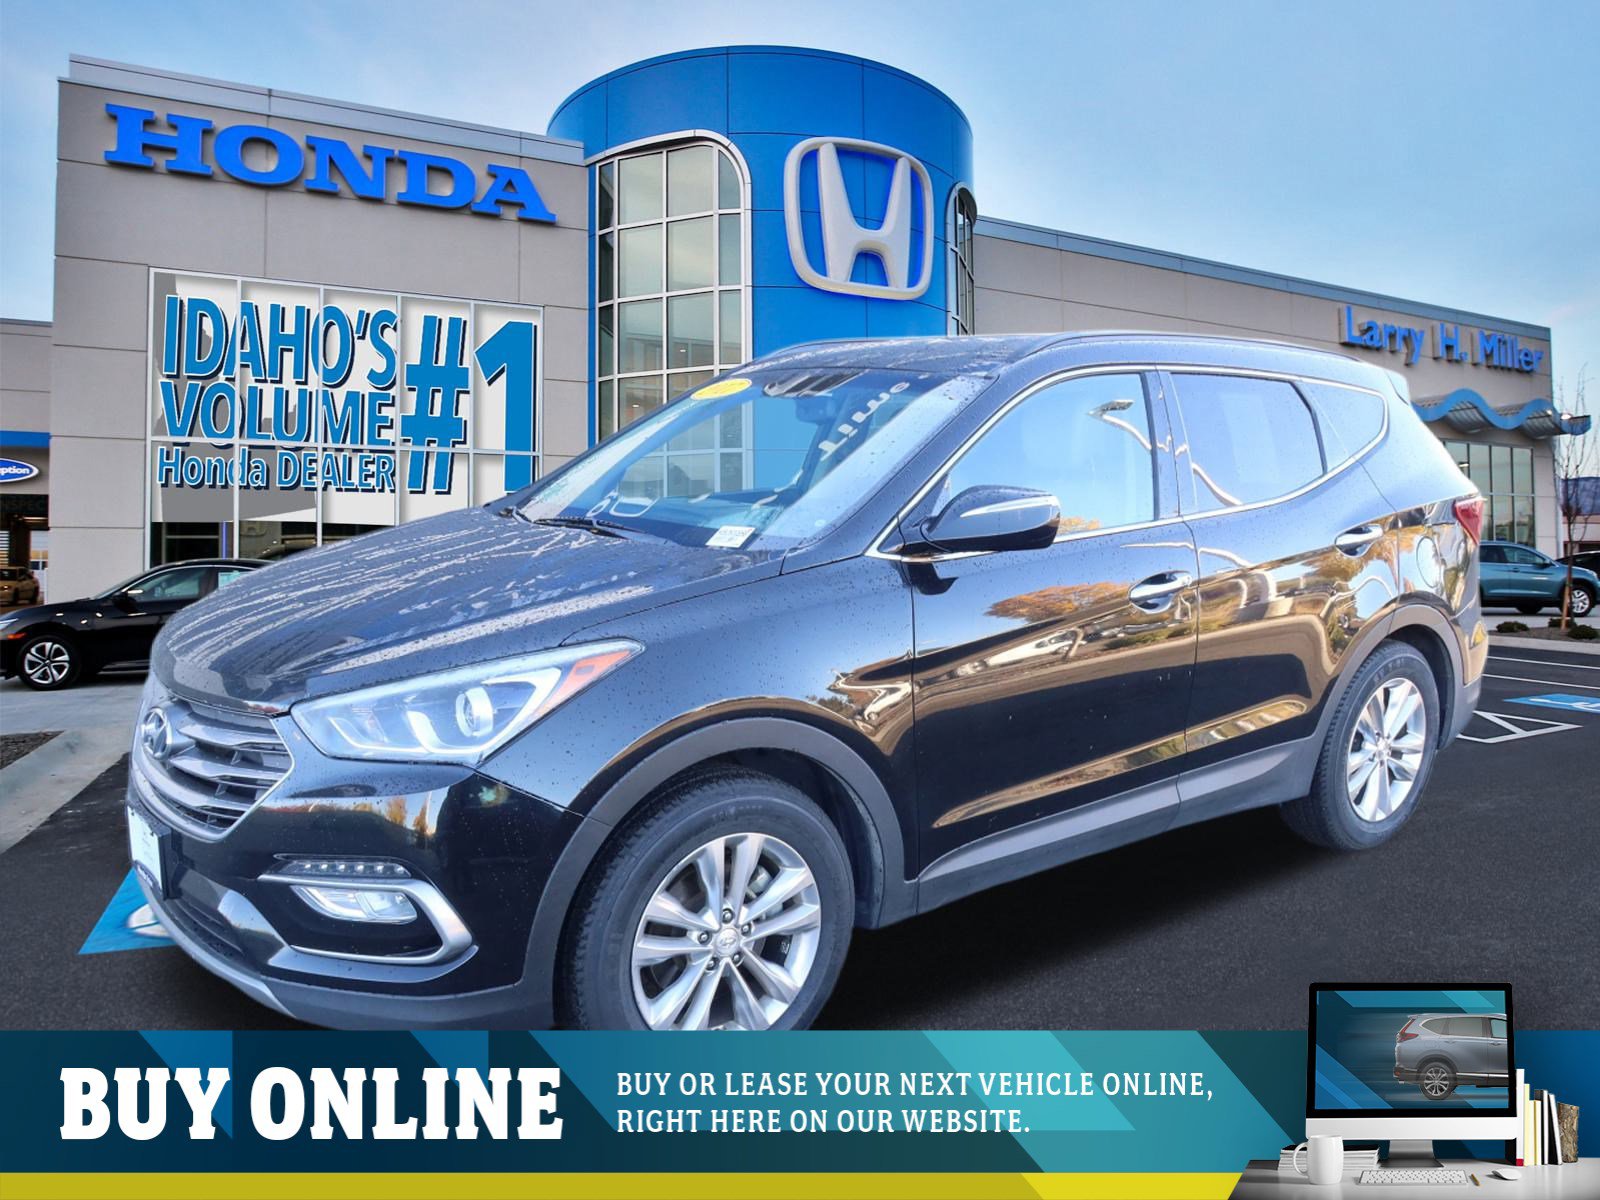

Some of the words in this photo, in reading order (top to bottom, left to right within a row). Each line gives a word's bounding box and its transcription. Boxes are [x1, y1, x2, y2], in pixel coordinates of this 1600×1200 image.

[103, 102, 557, 223] HONDA
[162, 294, 399, 389] IDAHO'S
[1341, 305, 1425, 366] Larry
[1438, 322, 1469, 362] H.
[1478, 328, 1544, 373] Miller
[159, 379, 397, 450] VOLUME
[401, 314, 541, 494] #1
[0, 465, 30, 477] ption
[157, 446, 268, 488] Honda
[276, 448, 397, 492] DEALER
